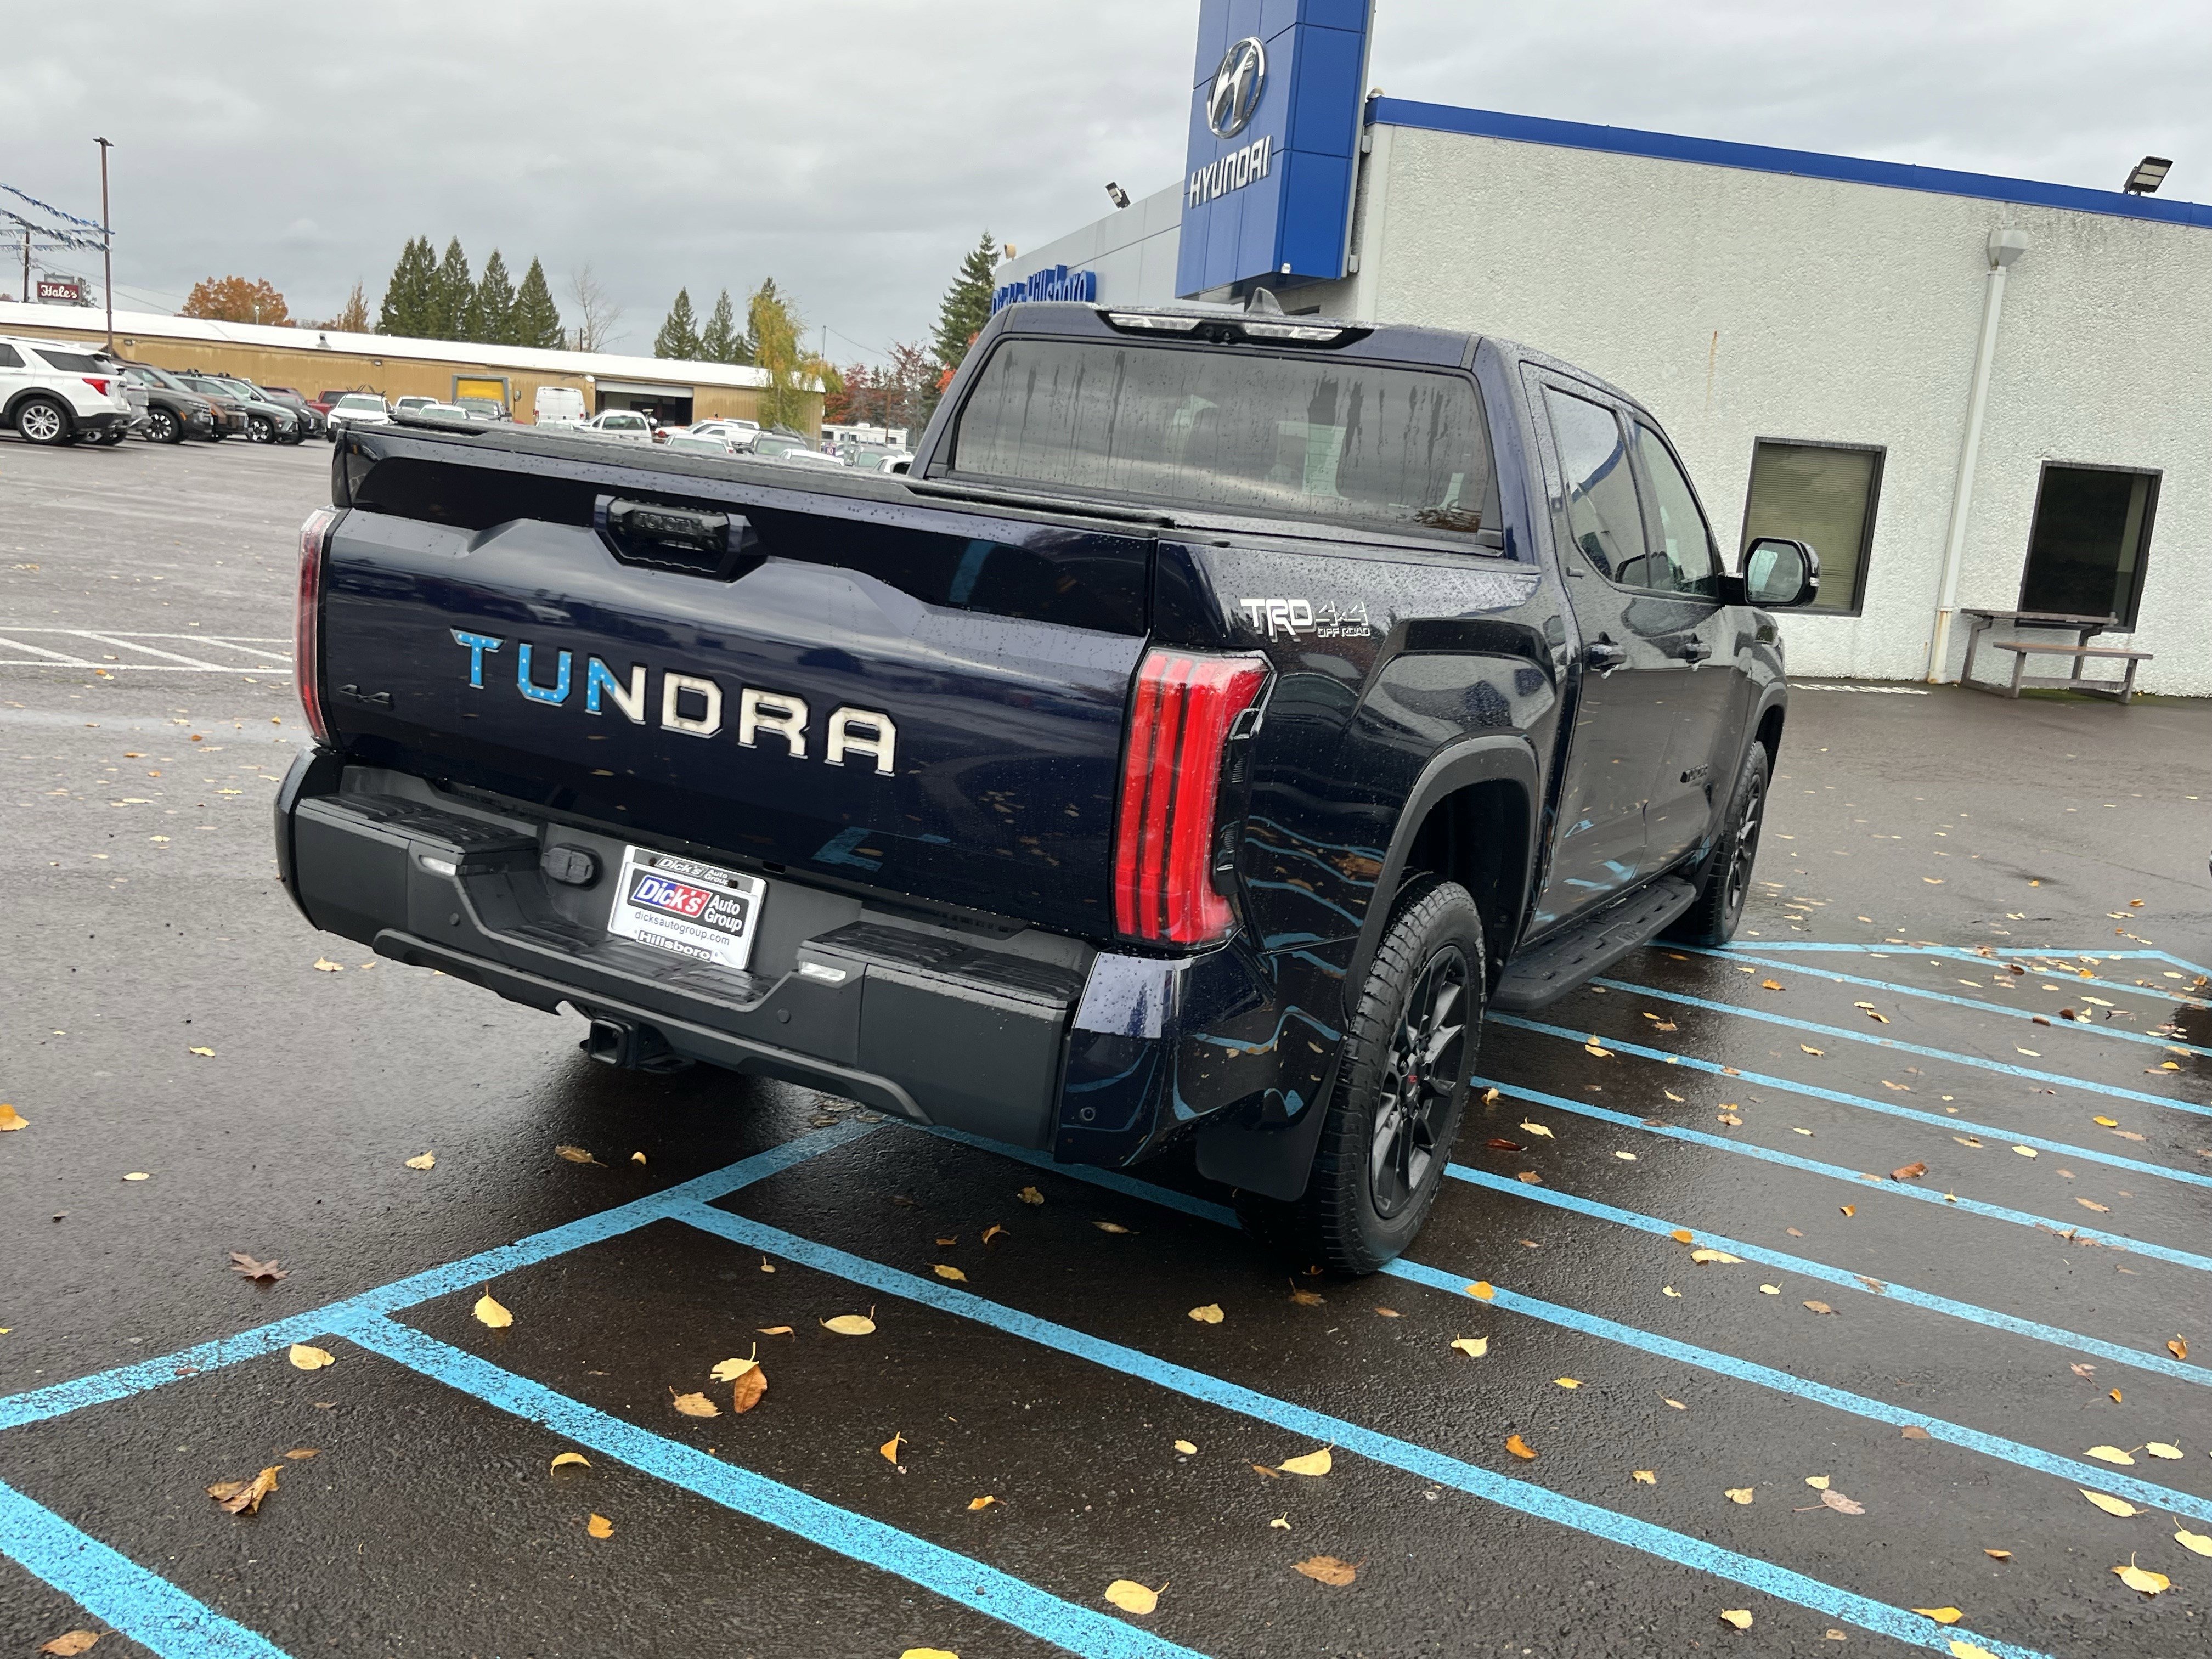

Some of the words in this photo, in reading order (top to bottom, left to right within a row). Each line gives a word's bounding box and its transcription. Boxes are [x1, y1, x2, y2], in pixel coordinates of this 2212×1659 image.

[1189, 136, 1273, 208] HYUNDAI
[41, 285, 77, 298] Hale's
[1240, 599, 1316, 642] TRD
[1317, 627, 1340, 638] OFF
[1341, 627, 1371, 637] ROAD
[450, 628, 897, 776] TUNDRA
[658, 858, 703, 876] Dick's
[707, 869, 729, 879] Auto
[636, 879, 703, 913] Dick's
[708, 895, 741, 916] Auto
[635, 910, 730, 946] dicksautogroup.com
[704, 908, 743, 933] Group
[639, 930, 711, 960] Hillsboro
